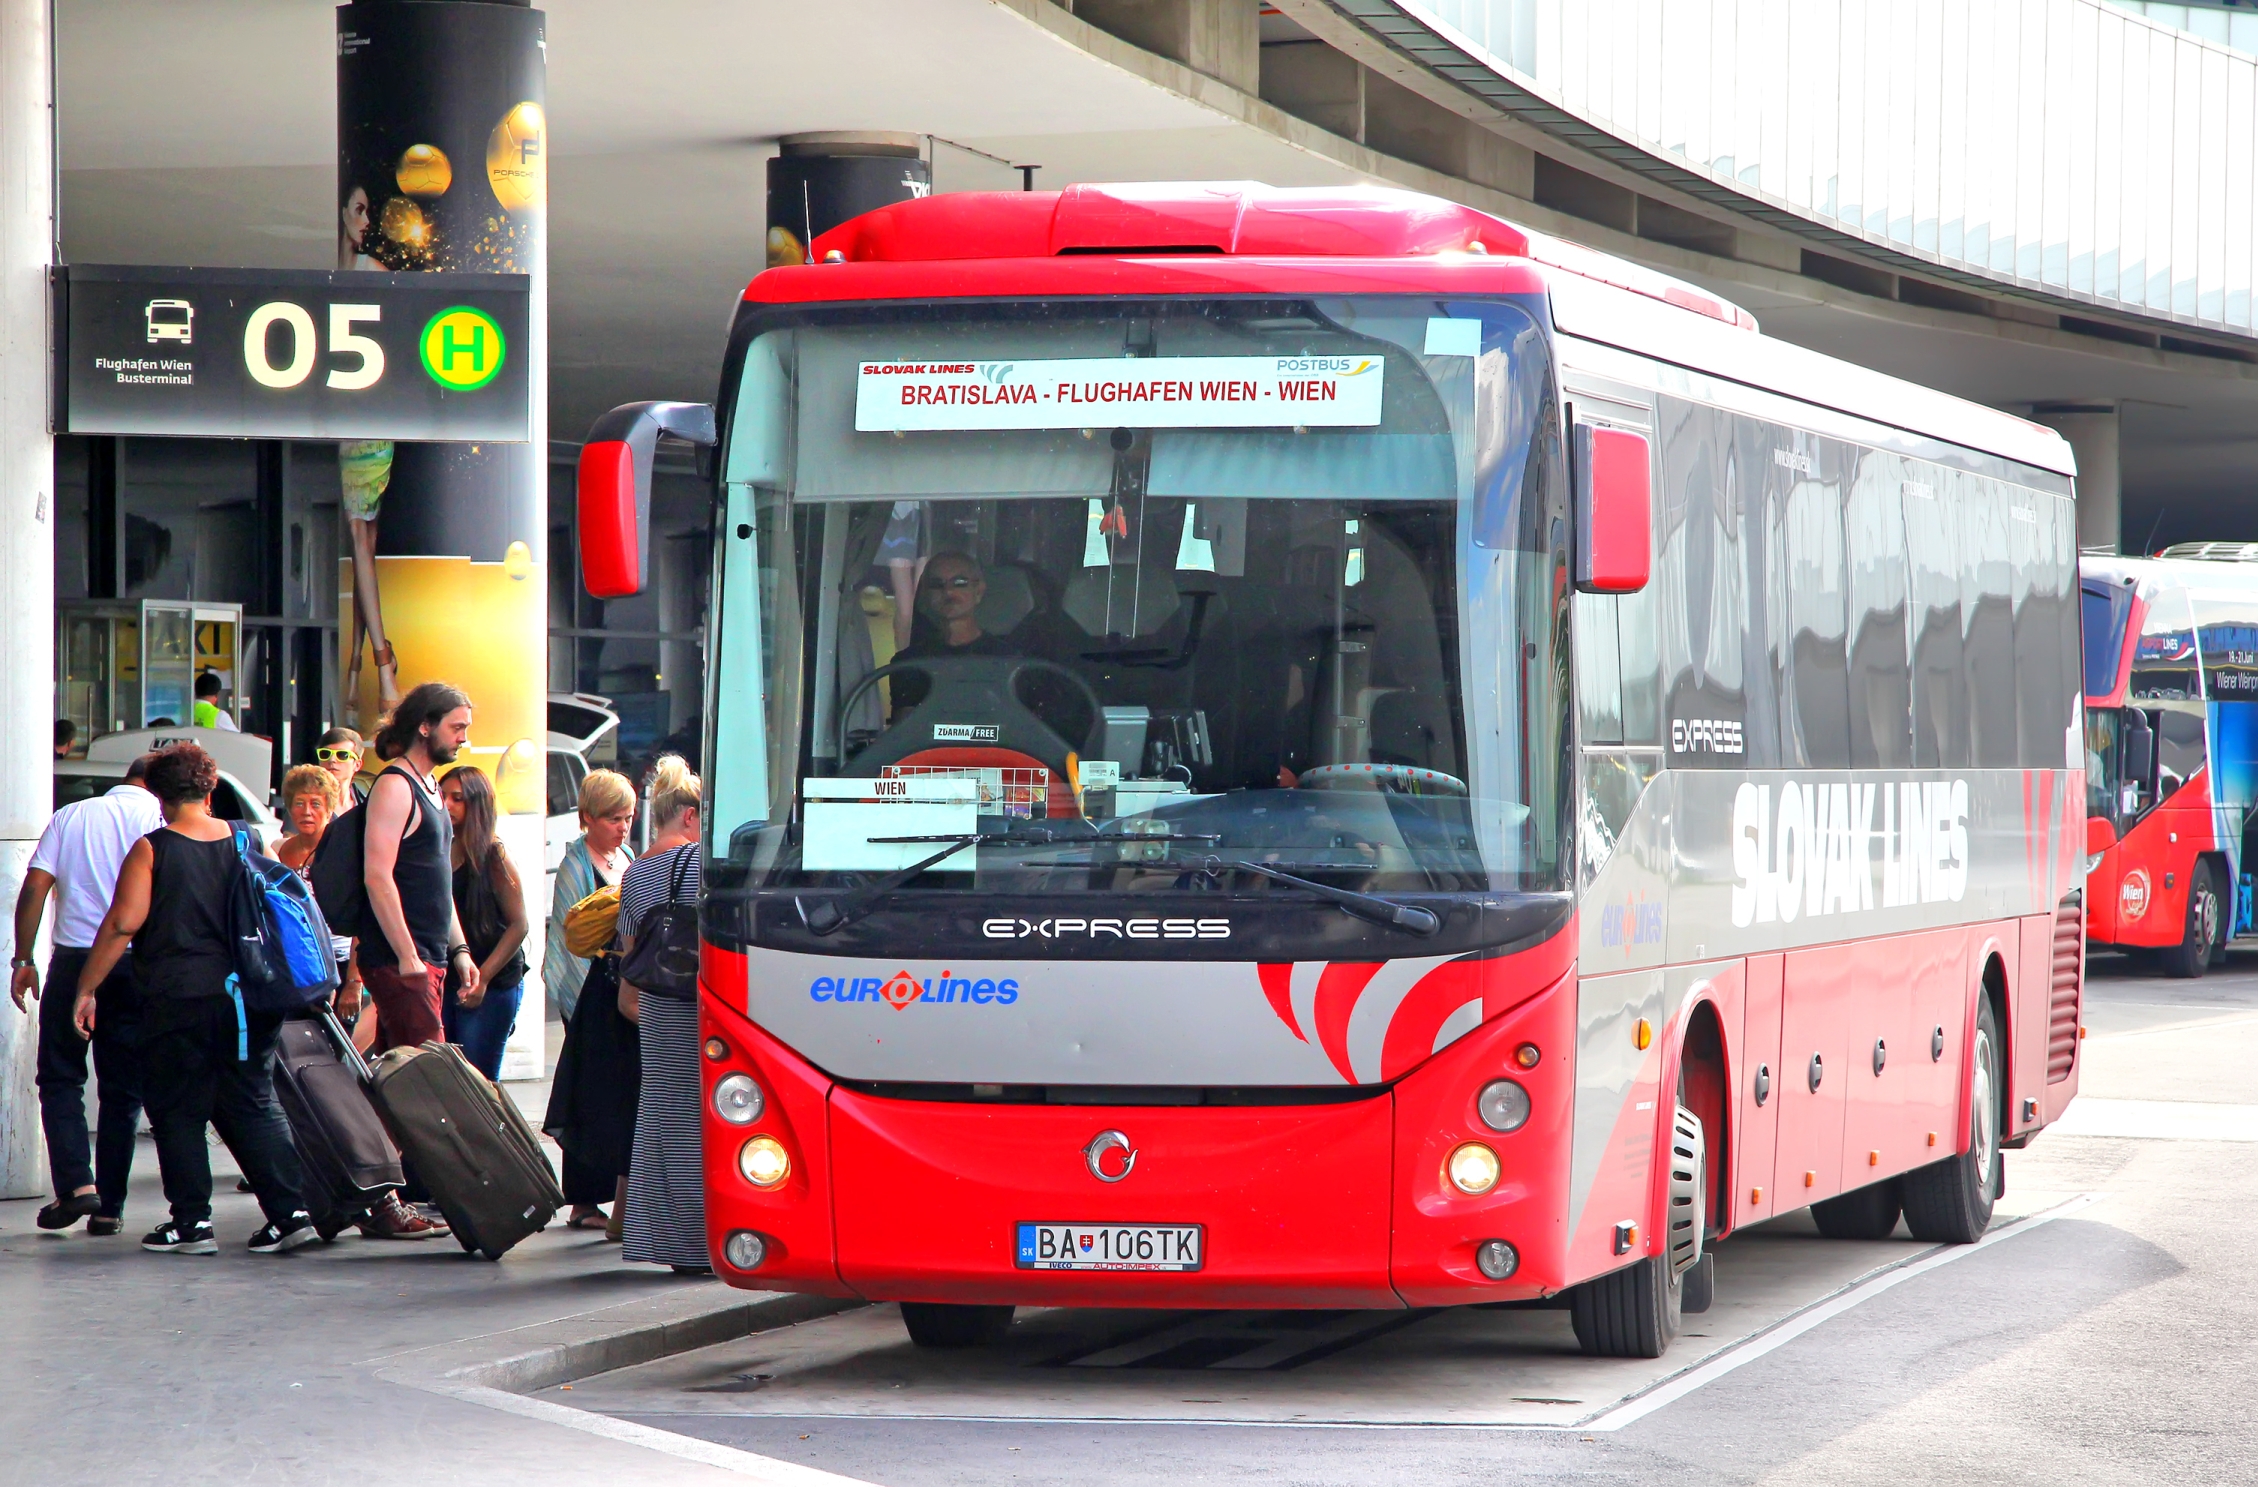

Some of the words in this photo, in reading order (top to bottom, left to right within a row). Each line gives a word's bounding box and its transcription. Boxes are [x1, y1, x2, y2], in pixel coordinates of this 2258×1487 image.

[243, 301, 386, 390] 05
[442, 325, 484, 371] H
[95, 358, 158, 371] Flughafen
[160, 359, 192, 371] Wien
[863, 364, 927, 375] SLOVAK
[929, 364, 975, 374] LINES
[1277, 359, 1351, 371] POSTBUS
[116, 373, 192, 385] Busterminal
[901, 384, 1038, 405] BRATISLAVA
[1057, 381, 1193, 403] FLUGHAFEN
[1199, 381, 1257, 401] WIEN
[1278, 380, 1336, 401] WIEN
[1672, 718, 1743, 754] EXPRESS
[874, 781, 906, 796] WIEN
[1731, 780, 1876, 928] SLOVAK
[1883, 779, 1969, 908] LINES
[2123, 884, 2144, 900] Wien
[982, 918, 1231, 939] EXPRESS
[1022, 1248, 1033, 1256] SK
[1039, 1228, 1076, 1258] BA
[1099, 1229, 1194, 1261] 106TK
